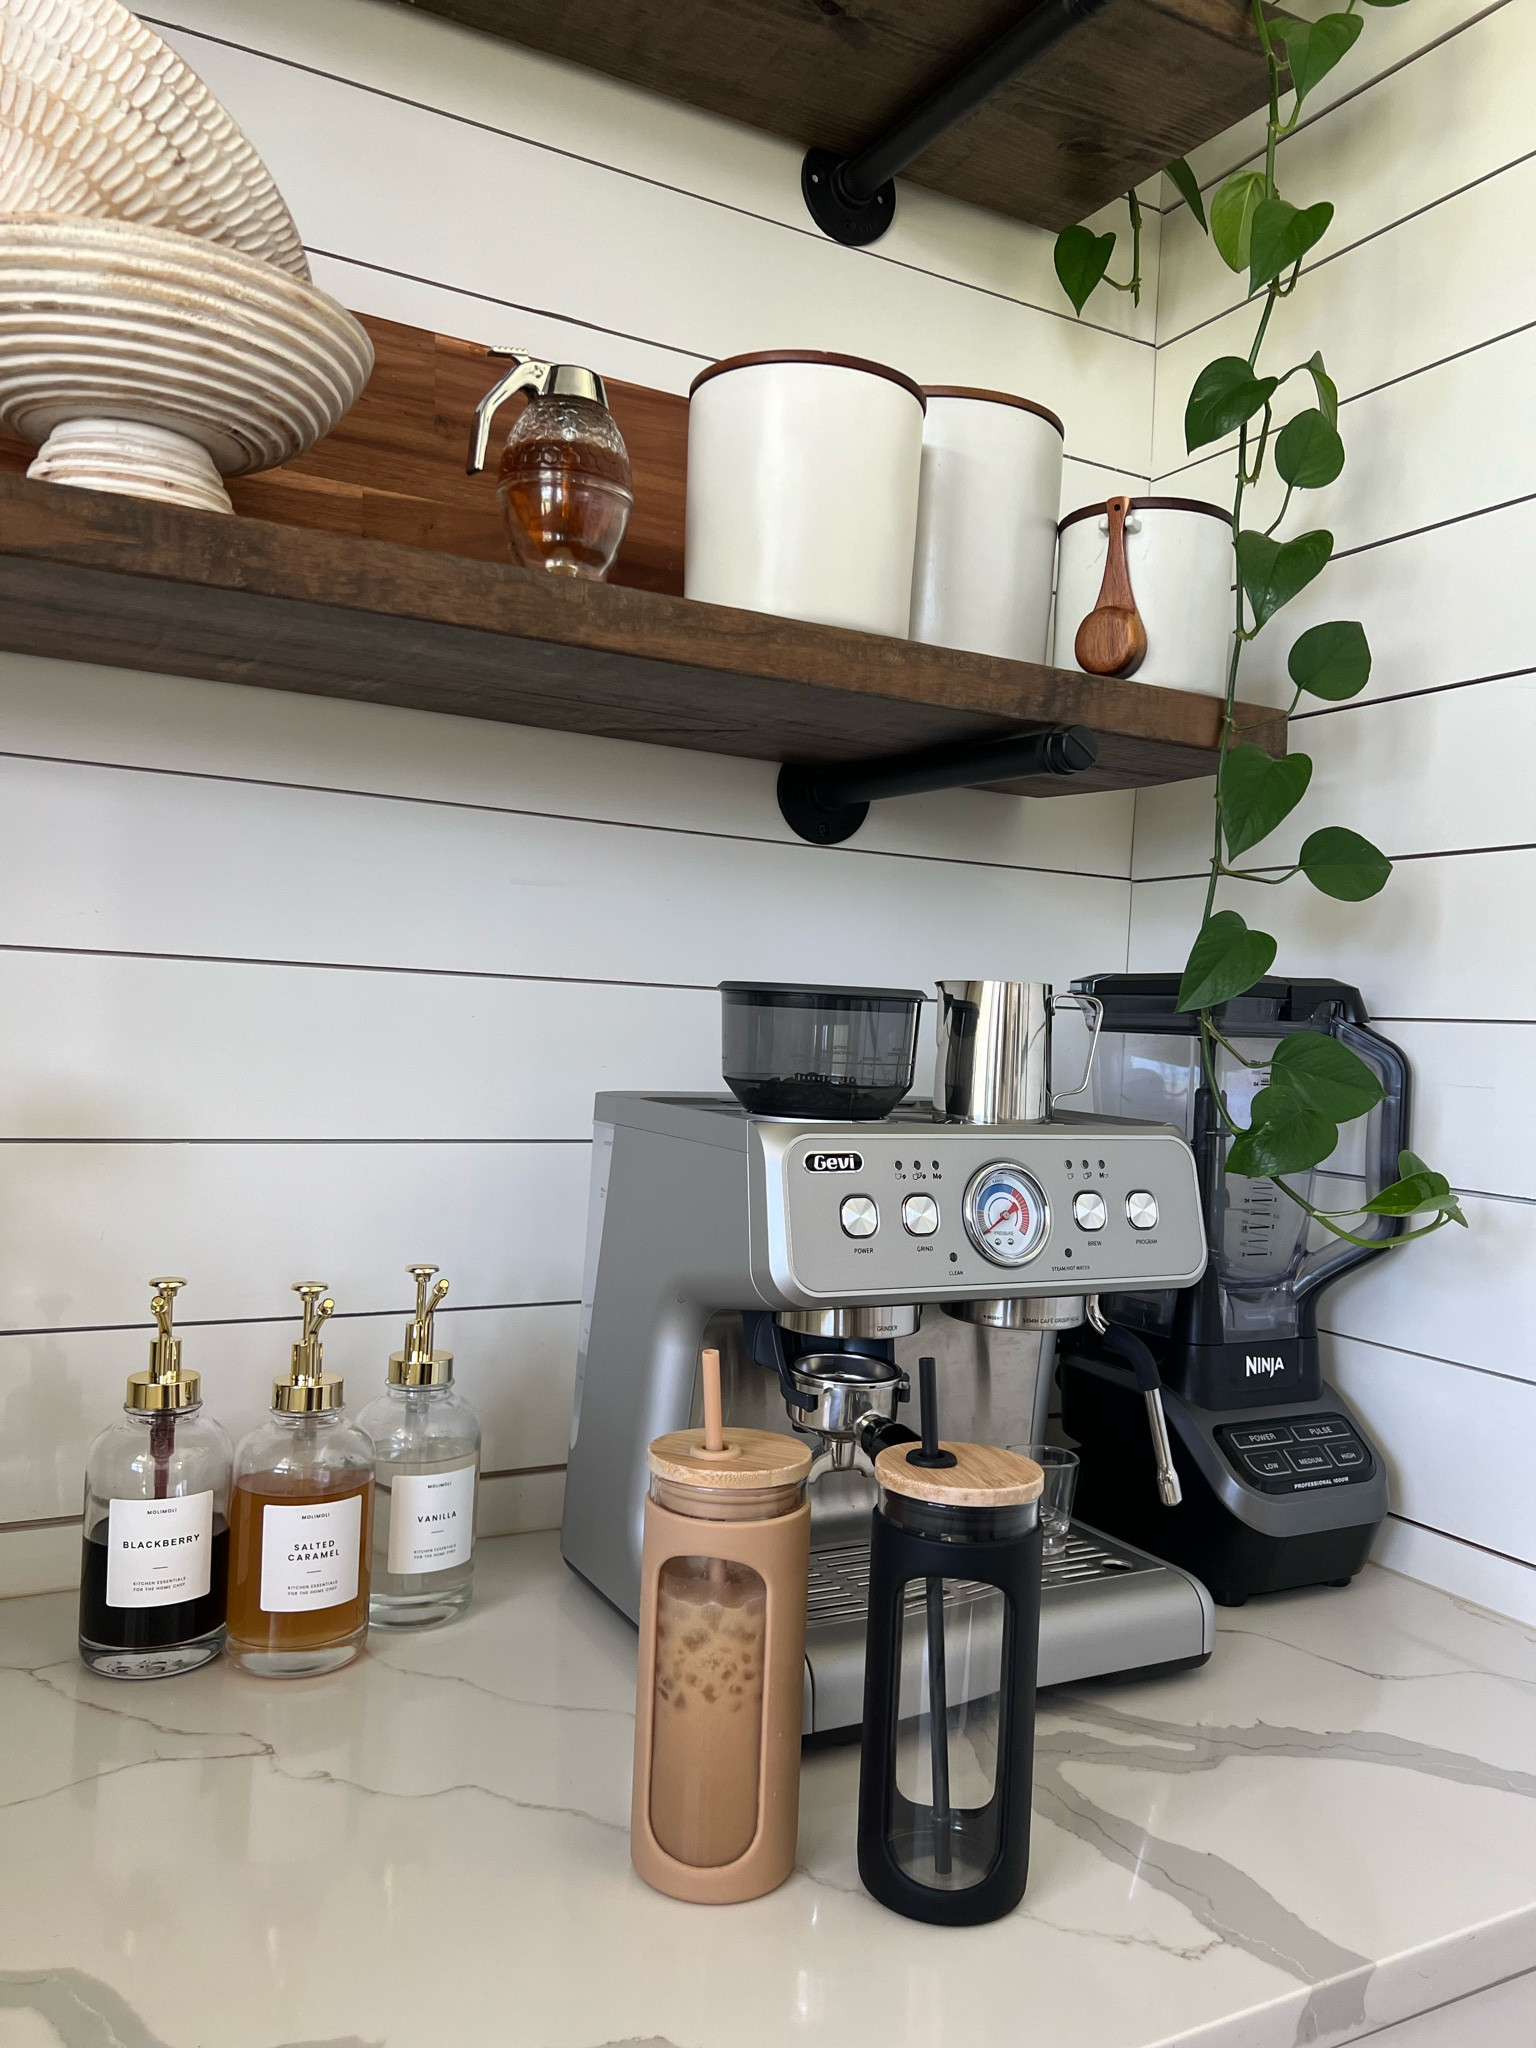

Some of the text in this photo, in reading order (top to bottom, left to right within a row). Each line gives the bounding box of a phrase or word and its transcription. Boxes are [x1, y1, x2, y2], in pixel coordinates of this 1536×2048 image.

[813, 1154, 855, 1170] Gevi
[1246, 1355, 1284, 1378] NINJA
[1309, 1427, 1333, 1435] PULSE
[1249, 1433, 1276, 1442] POWER
[1298, 1457, 1324, 1465] MEDIUM
[1294, 1479, 1332, 1489] PROFESSIONAL
[417, 1510, 457, 1523] VANILLA
[123, 1533, 200, 1549] BLACKBERRY
[294, 1540, 335, 1551] SALTED
[434, 1544, 456, 1552] ESSENTIALS
[288, 1549, 340, 1561] CARAMEL
[157, 1576, 186, 1585] ESSENTIALS
[310, 1580, 338, 1589] ESSENTIALS
